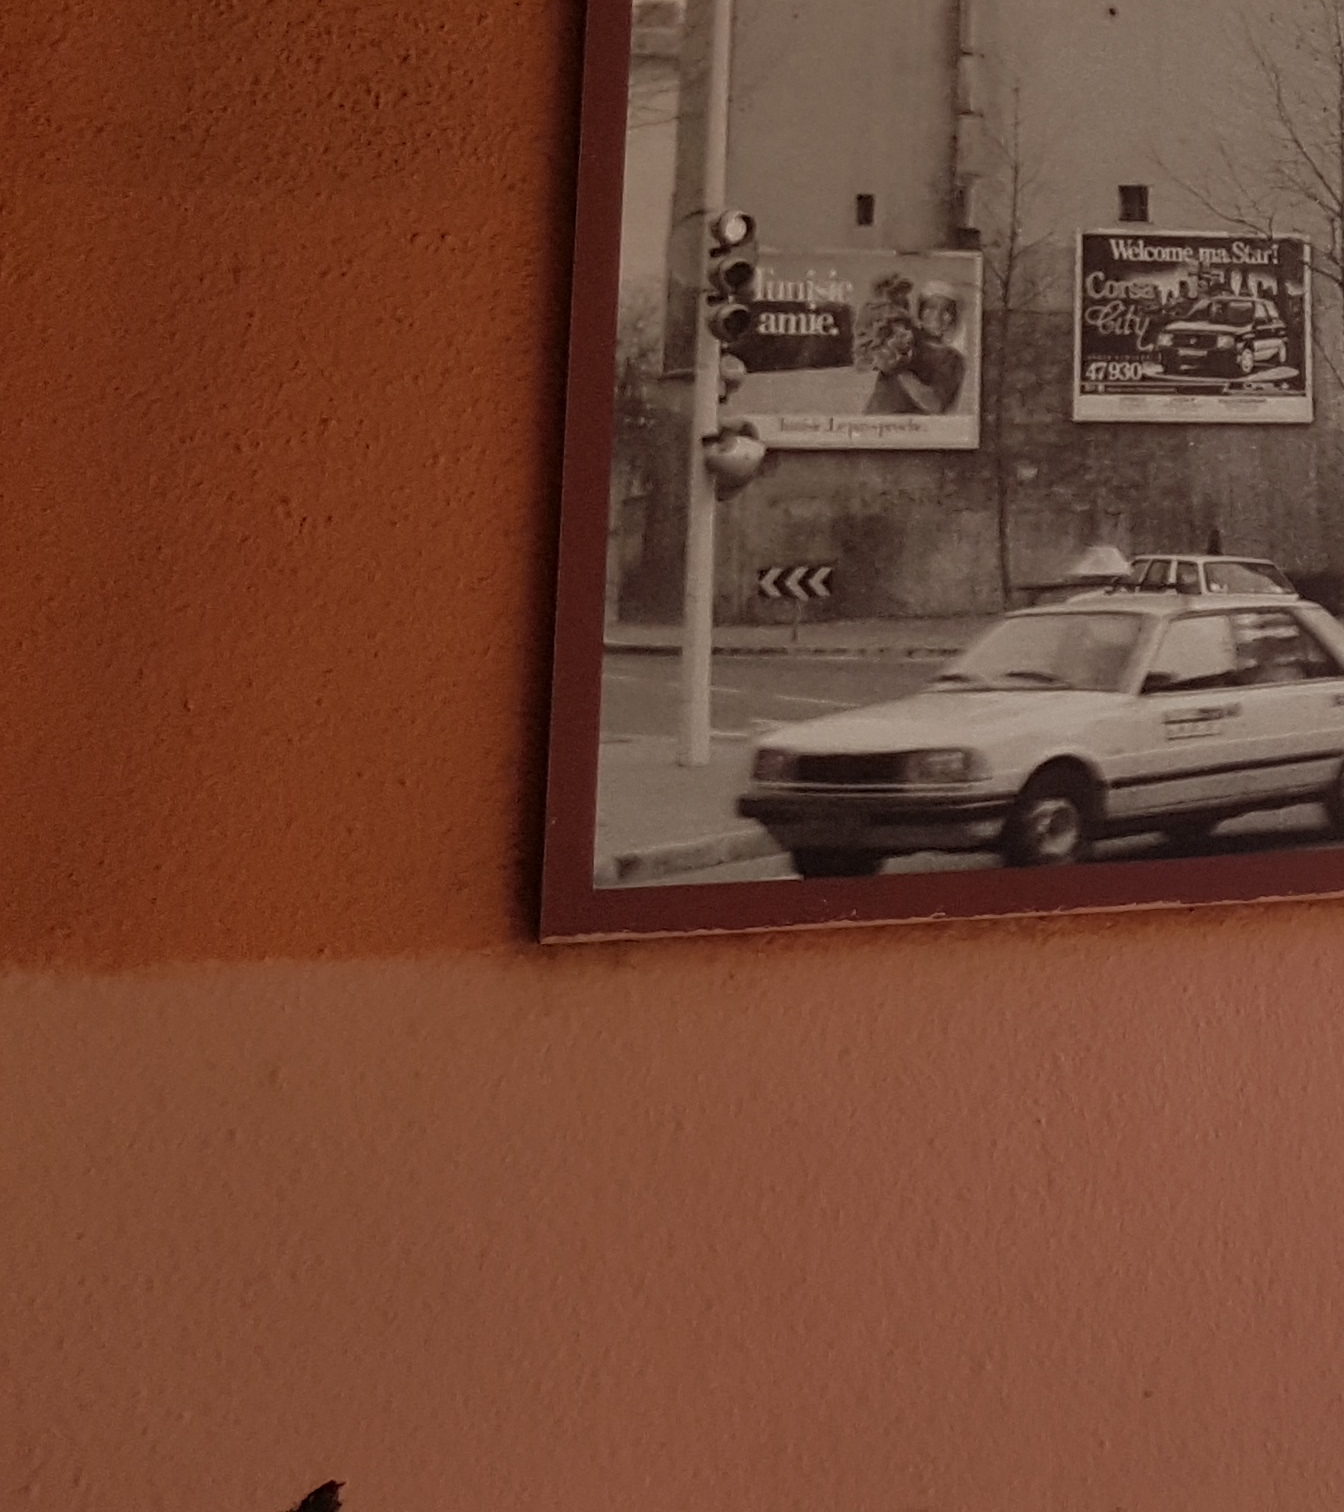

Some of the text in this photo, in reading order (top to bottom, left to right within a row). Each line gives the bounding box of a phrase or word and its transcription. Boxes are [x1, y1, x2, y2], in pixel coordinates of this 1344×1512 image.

[1109, 238, 1194, 263] Welcome
[1231, 241, 1279, 264] Star!
[1085, 270, 1156, 299] Corsa
[757, 303, 840, 337] amie.
[1085, 300, 1154, 351] City
